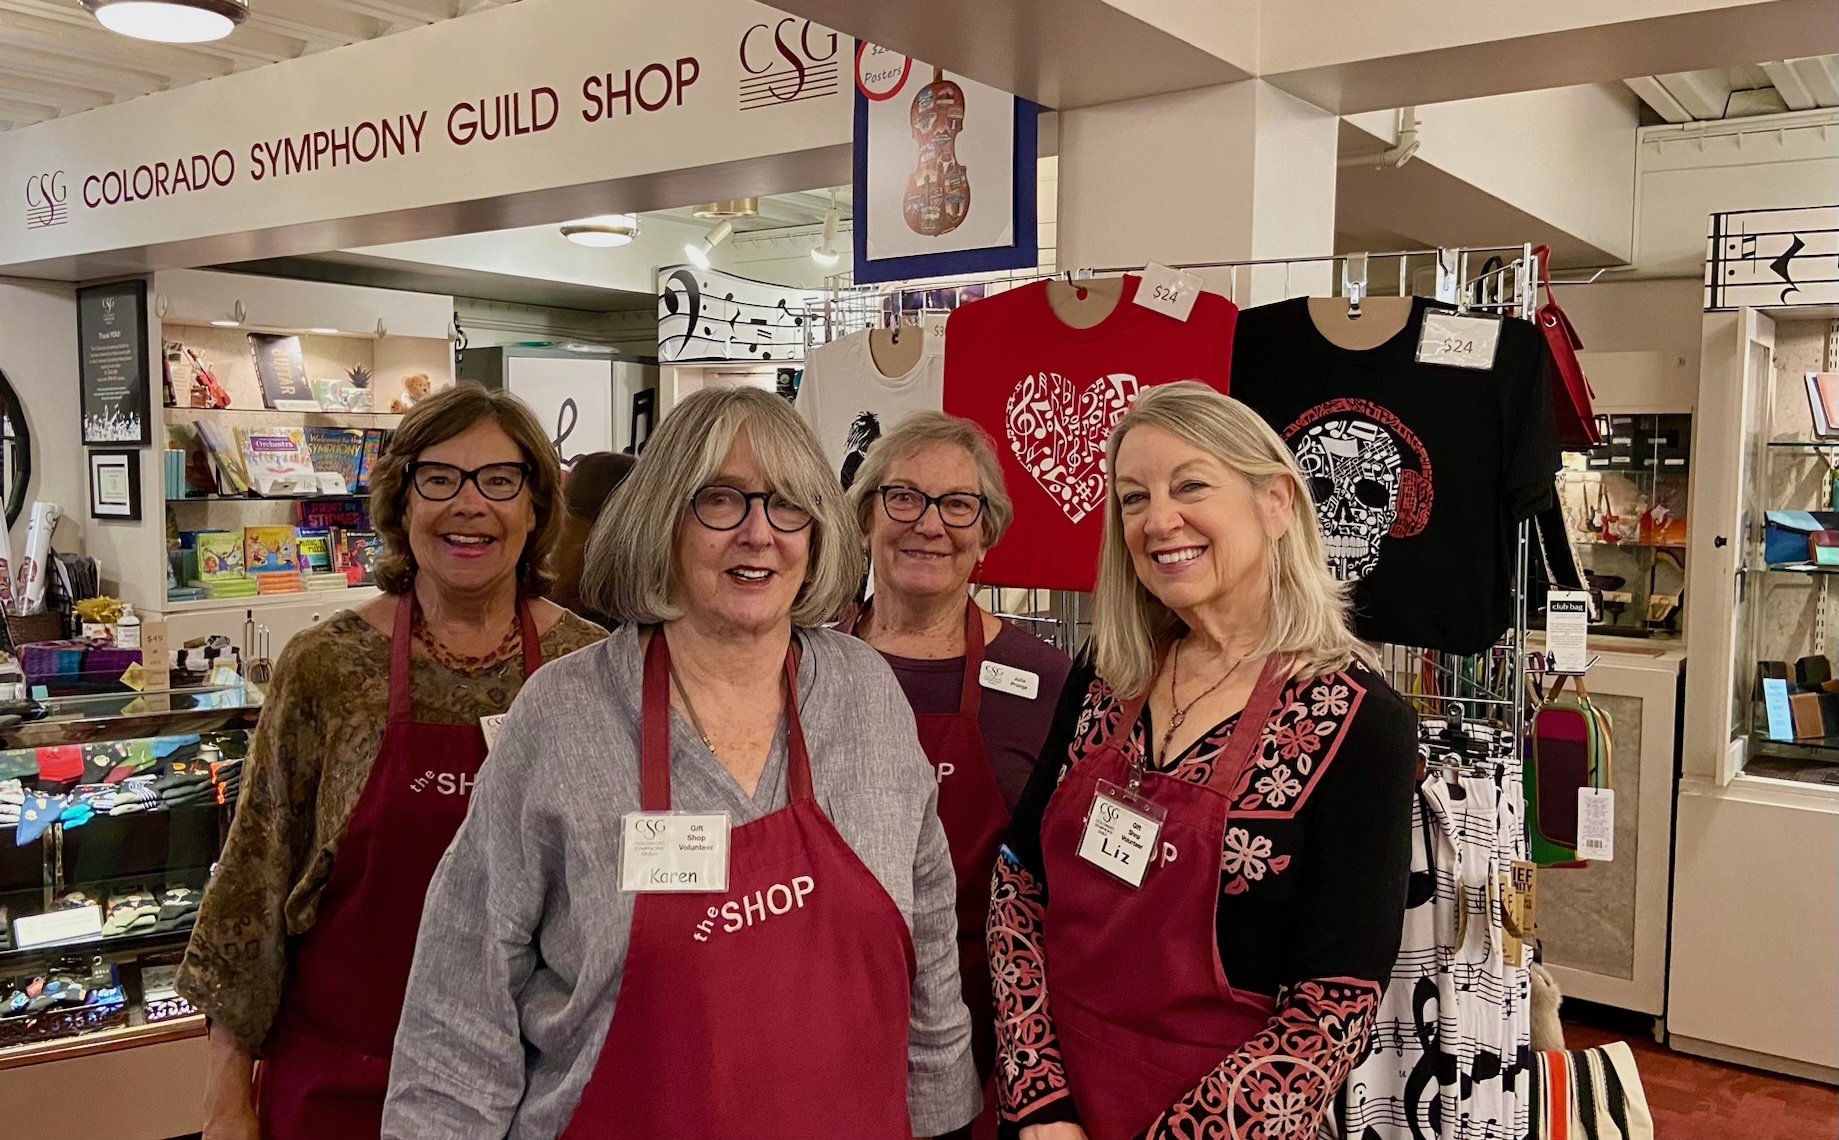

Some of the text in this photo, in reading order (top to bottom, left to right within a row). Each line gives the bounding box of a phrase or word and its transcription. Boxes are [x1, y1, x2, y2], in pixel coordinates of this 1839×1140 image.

[871, 44, 889, 56] $2
[738, 17, 838, 101] CSG
[864, 66, 902, 85] Posters
[83, 56, 701, 208] COLORADO SYMPHONY GUILD SHOP
[26, 170, 67, 226] CSG
[1152, 284, 1178, 304] $24
[1442, 337, 1473, 354] $24
[255, 439, 294, 448] Orchestra
[310, 432, 340, 443] Welcome
[308, 443, 361, 457] SYMPHONY
[356, 537, 378, 549] Rock
[1552, 602, 1584, 611] club bag
[147, 634, 163, 643] $49
[410, 770, 477, 796] the SH
[1100, 802, 1120, 823] CSG
[635, 819, 666, 841] CSG
[690, 824, 704, 832] Gift
[1128, 829, 1141, 840] Shop
[687, 834, 707, 842] Shop
[1121, 834, 1143, 850] Volunteer
[1101, 837, 1130, 866] Liz
[650, 868, 698, 884] Karen
[1512, 866, 1533, 883] IEF
[693, 875, 815, 942] the SHOP
